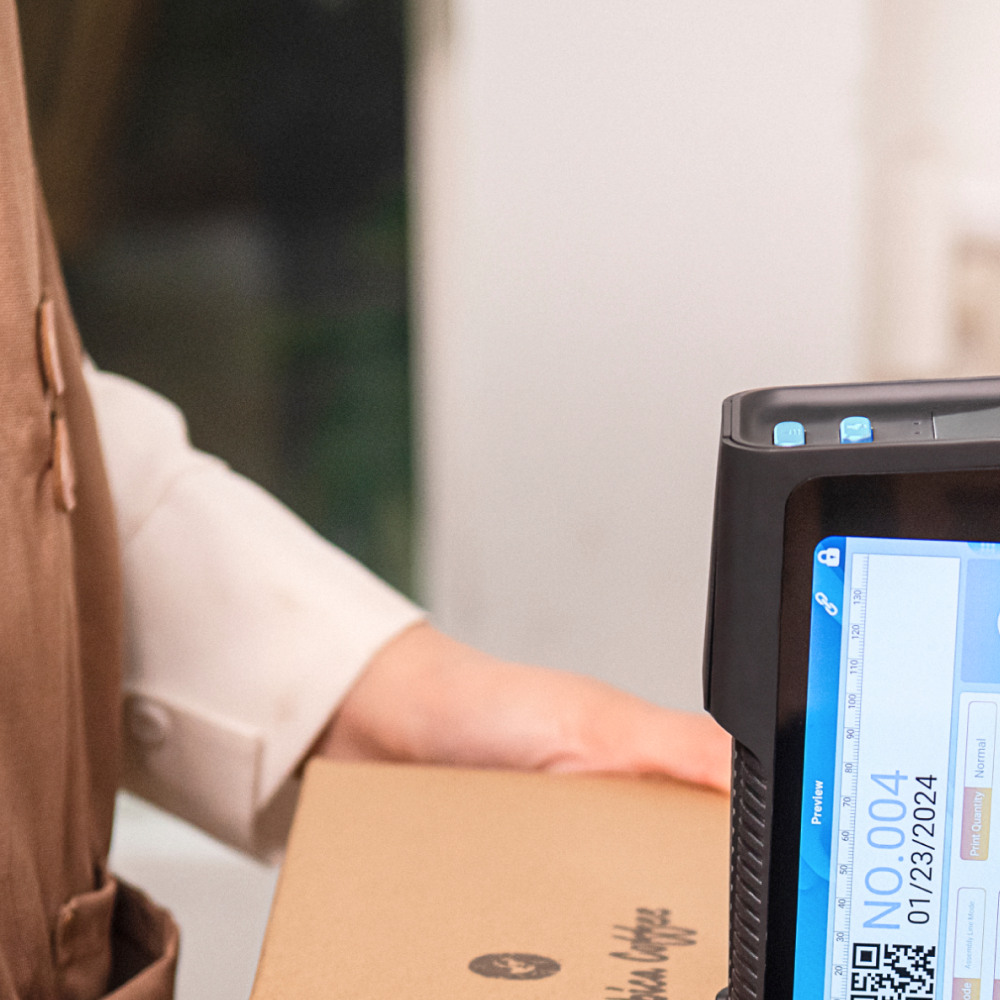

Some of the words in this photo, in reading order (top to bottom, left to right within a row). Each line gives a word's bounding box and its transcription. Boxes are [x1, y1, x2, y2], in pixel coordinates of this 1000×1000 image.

[853, 589, 862, 605] 130
[852, 624, 860, 640] 120
[850, 659, 858, 675] 110
[848, 694, 856, 709] 100
[846, 729, 855, 739] 90
[974, 738, 986, 779] Normal
[845, 763, 853, 773] 80
[811, 780, 824, 825] Preview
[843, 796, 851, 807] 70
[971, 791, 985, 832] Quantity
[842, 831, 850, 841] 60
[862, 770, 908, 929] NO.004
[907, 774, 937, 925] 01/23/2024
[970, 833, 981, 857] Print
[840, 865, 848, 875] 50
[838, 899, 846, 909] 40
[967, 900, 975, 919] Mode
[608, 907, 697, 962] Coffee
[836, 932, 845, 942] 30
[964, 936, 974, 969] Assembly
[835, 965, 843, 976] 20
